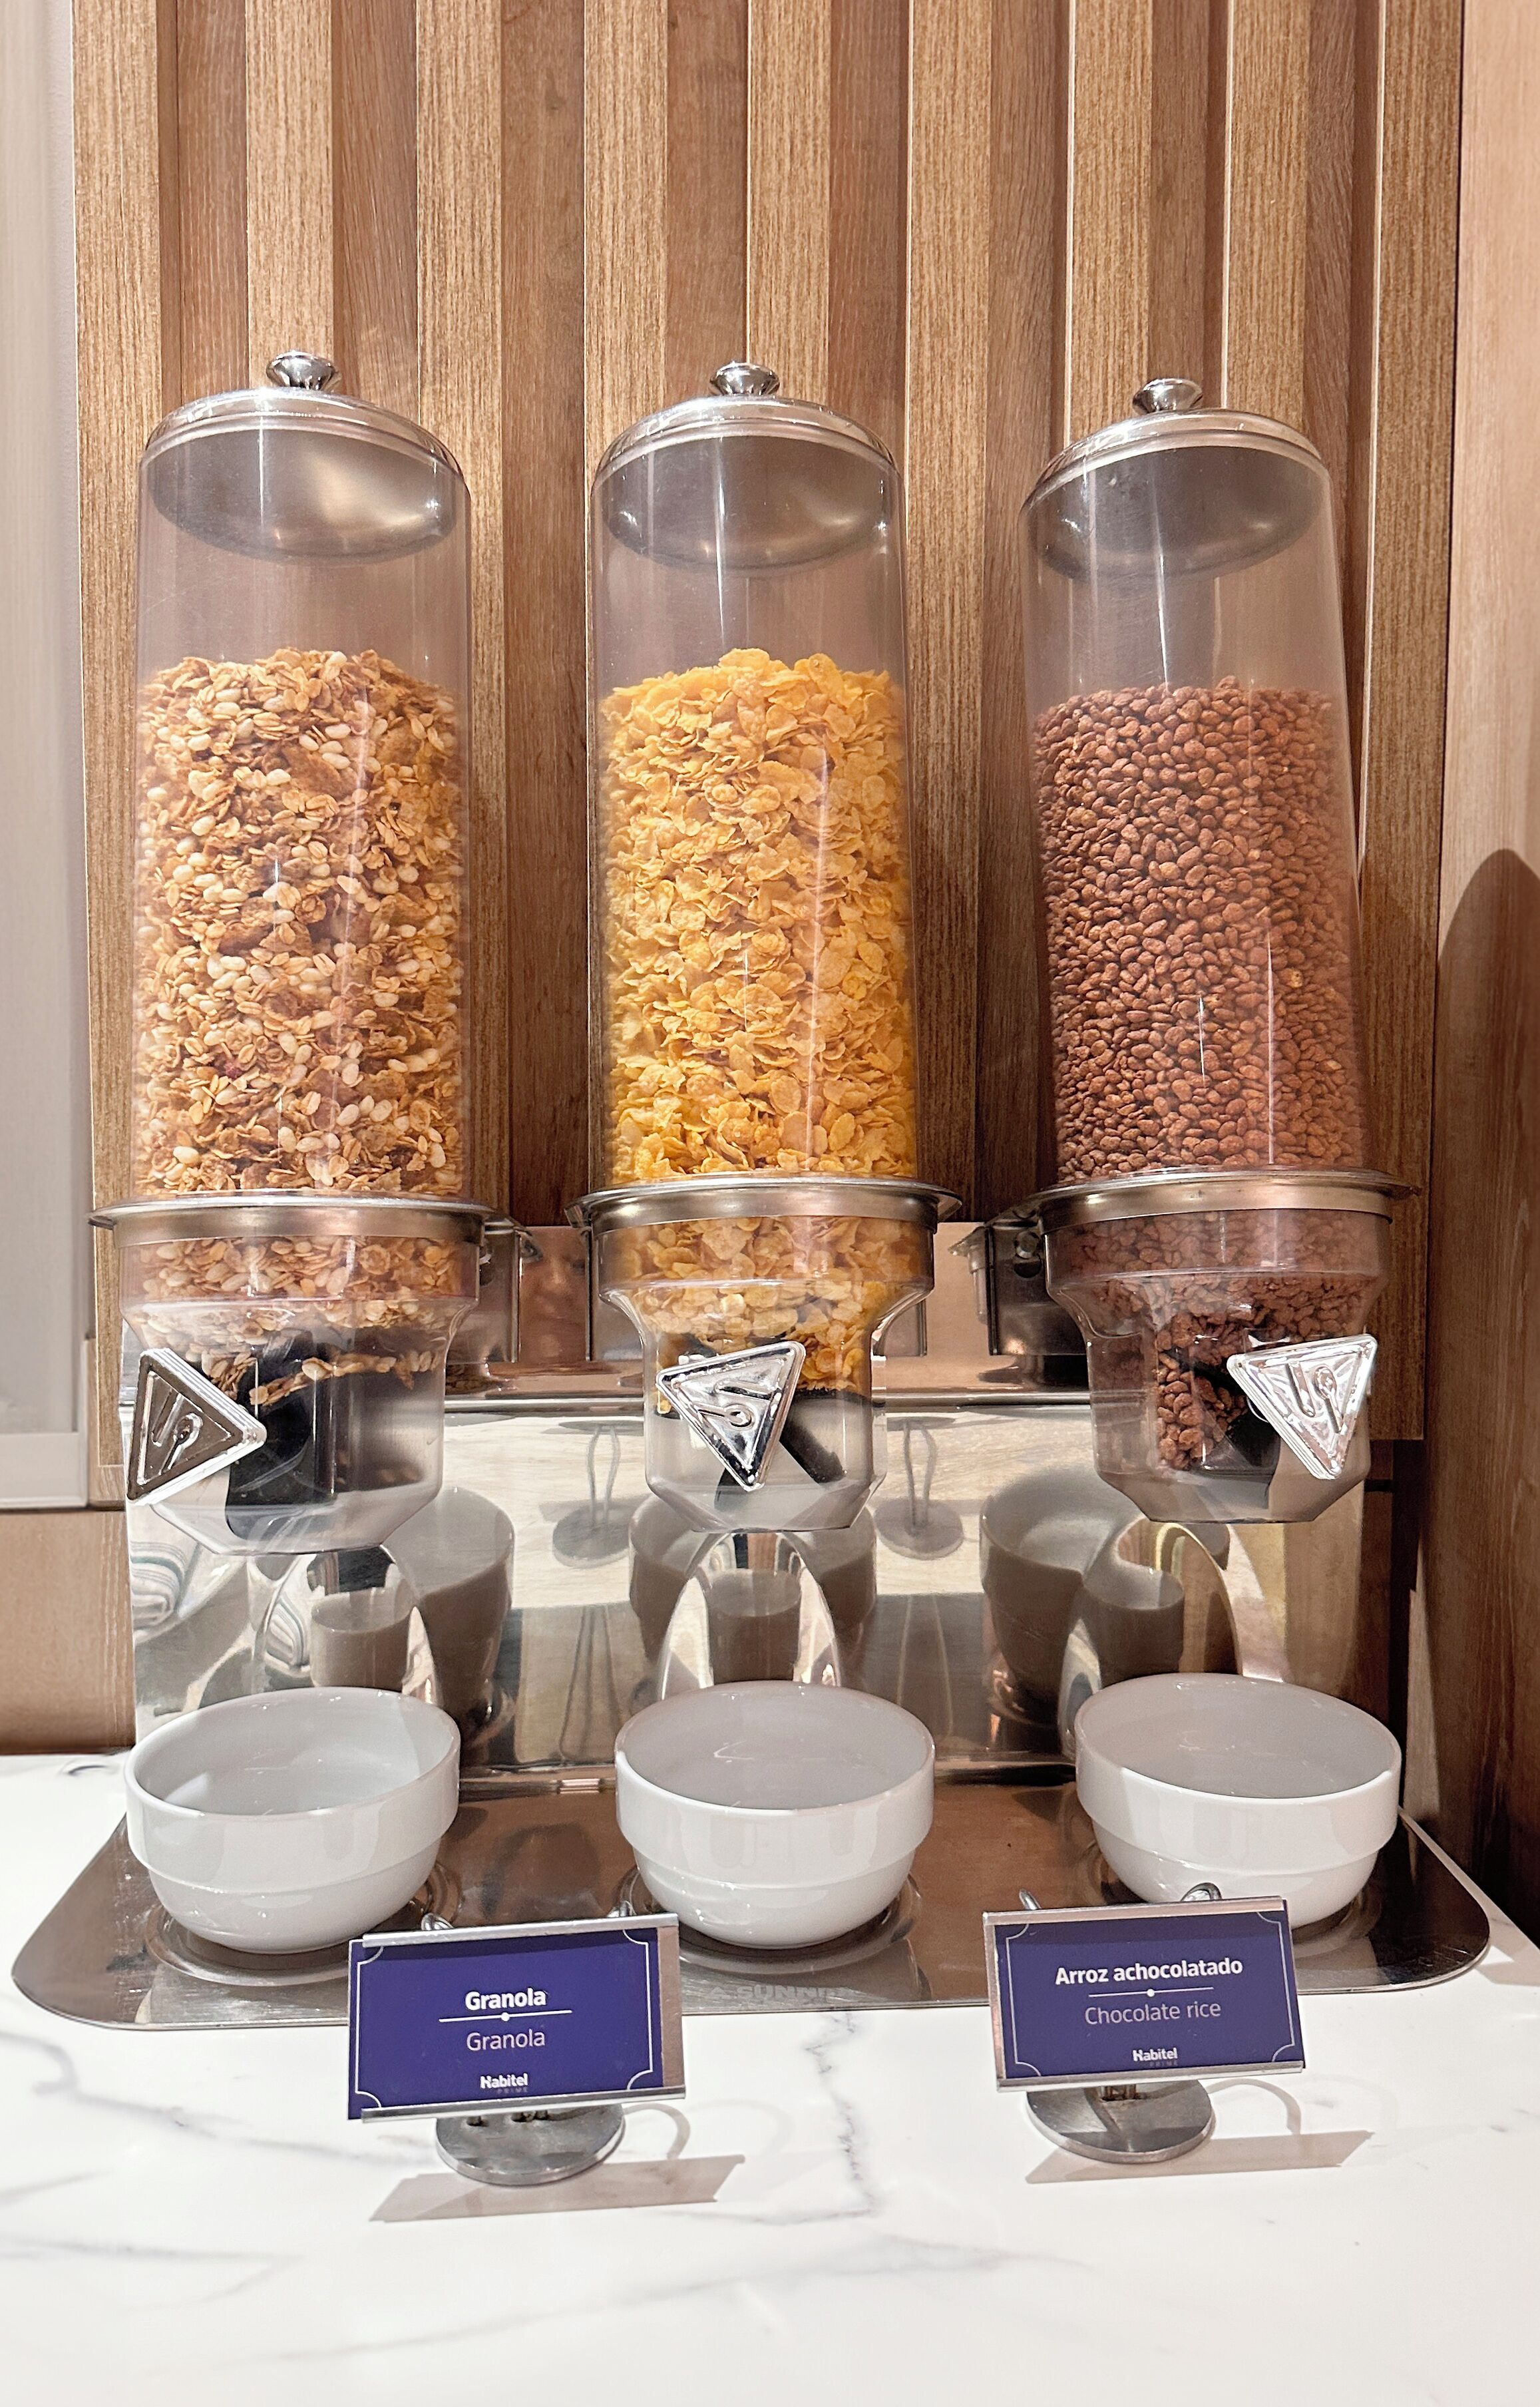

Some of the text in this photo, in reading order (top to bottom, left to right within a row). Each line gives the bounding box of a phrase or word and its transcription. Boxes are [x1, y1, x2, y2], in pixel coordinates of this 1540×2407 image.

[1055, 1957, 1243, 1986] Arroz achocolatado
[465, 1988, 547, 2011] Granola
[1085, 2001, 1221, 2025] Chocolate rice
[466, 2028, 546, 2052] Granola
[1132, 2047, 1178, 2062] Habitel
[480, 2072, 528, 2089] Habitel
